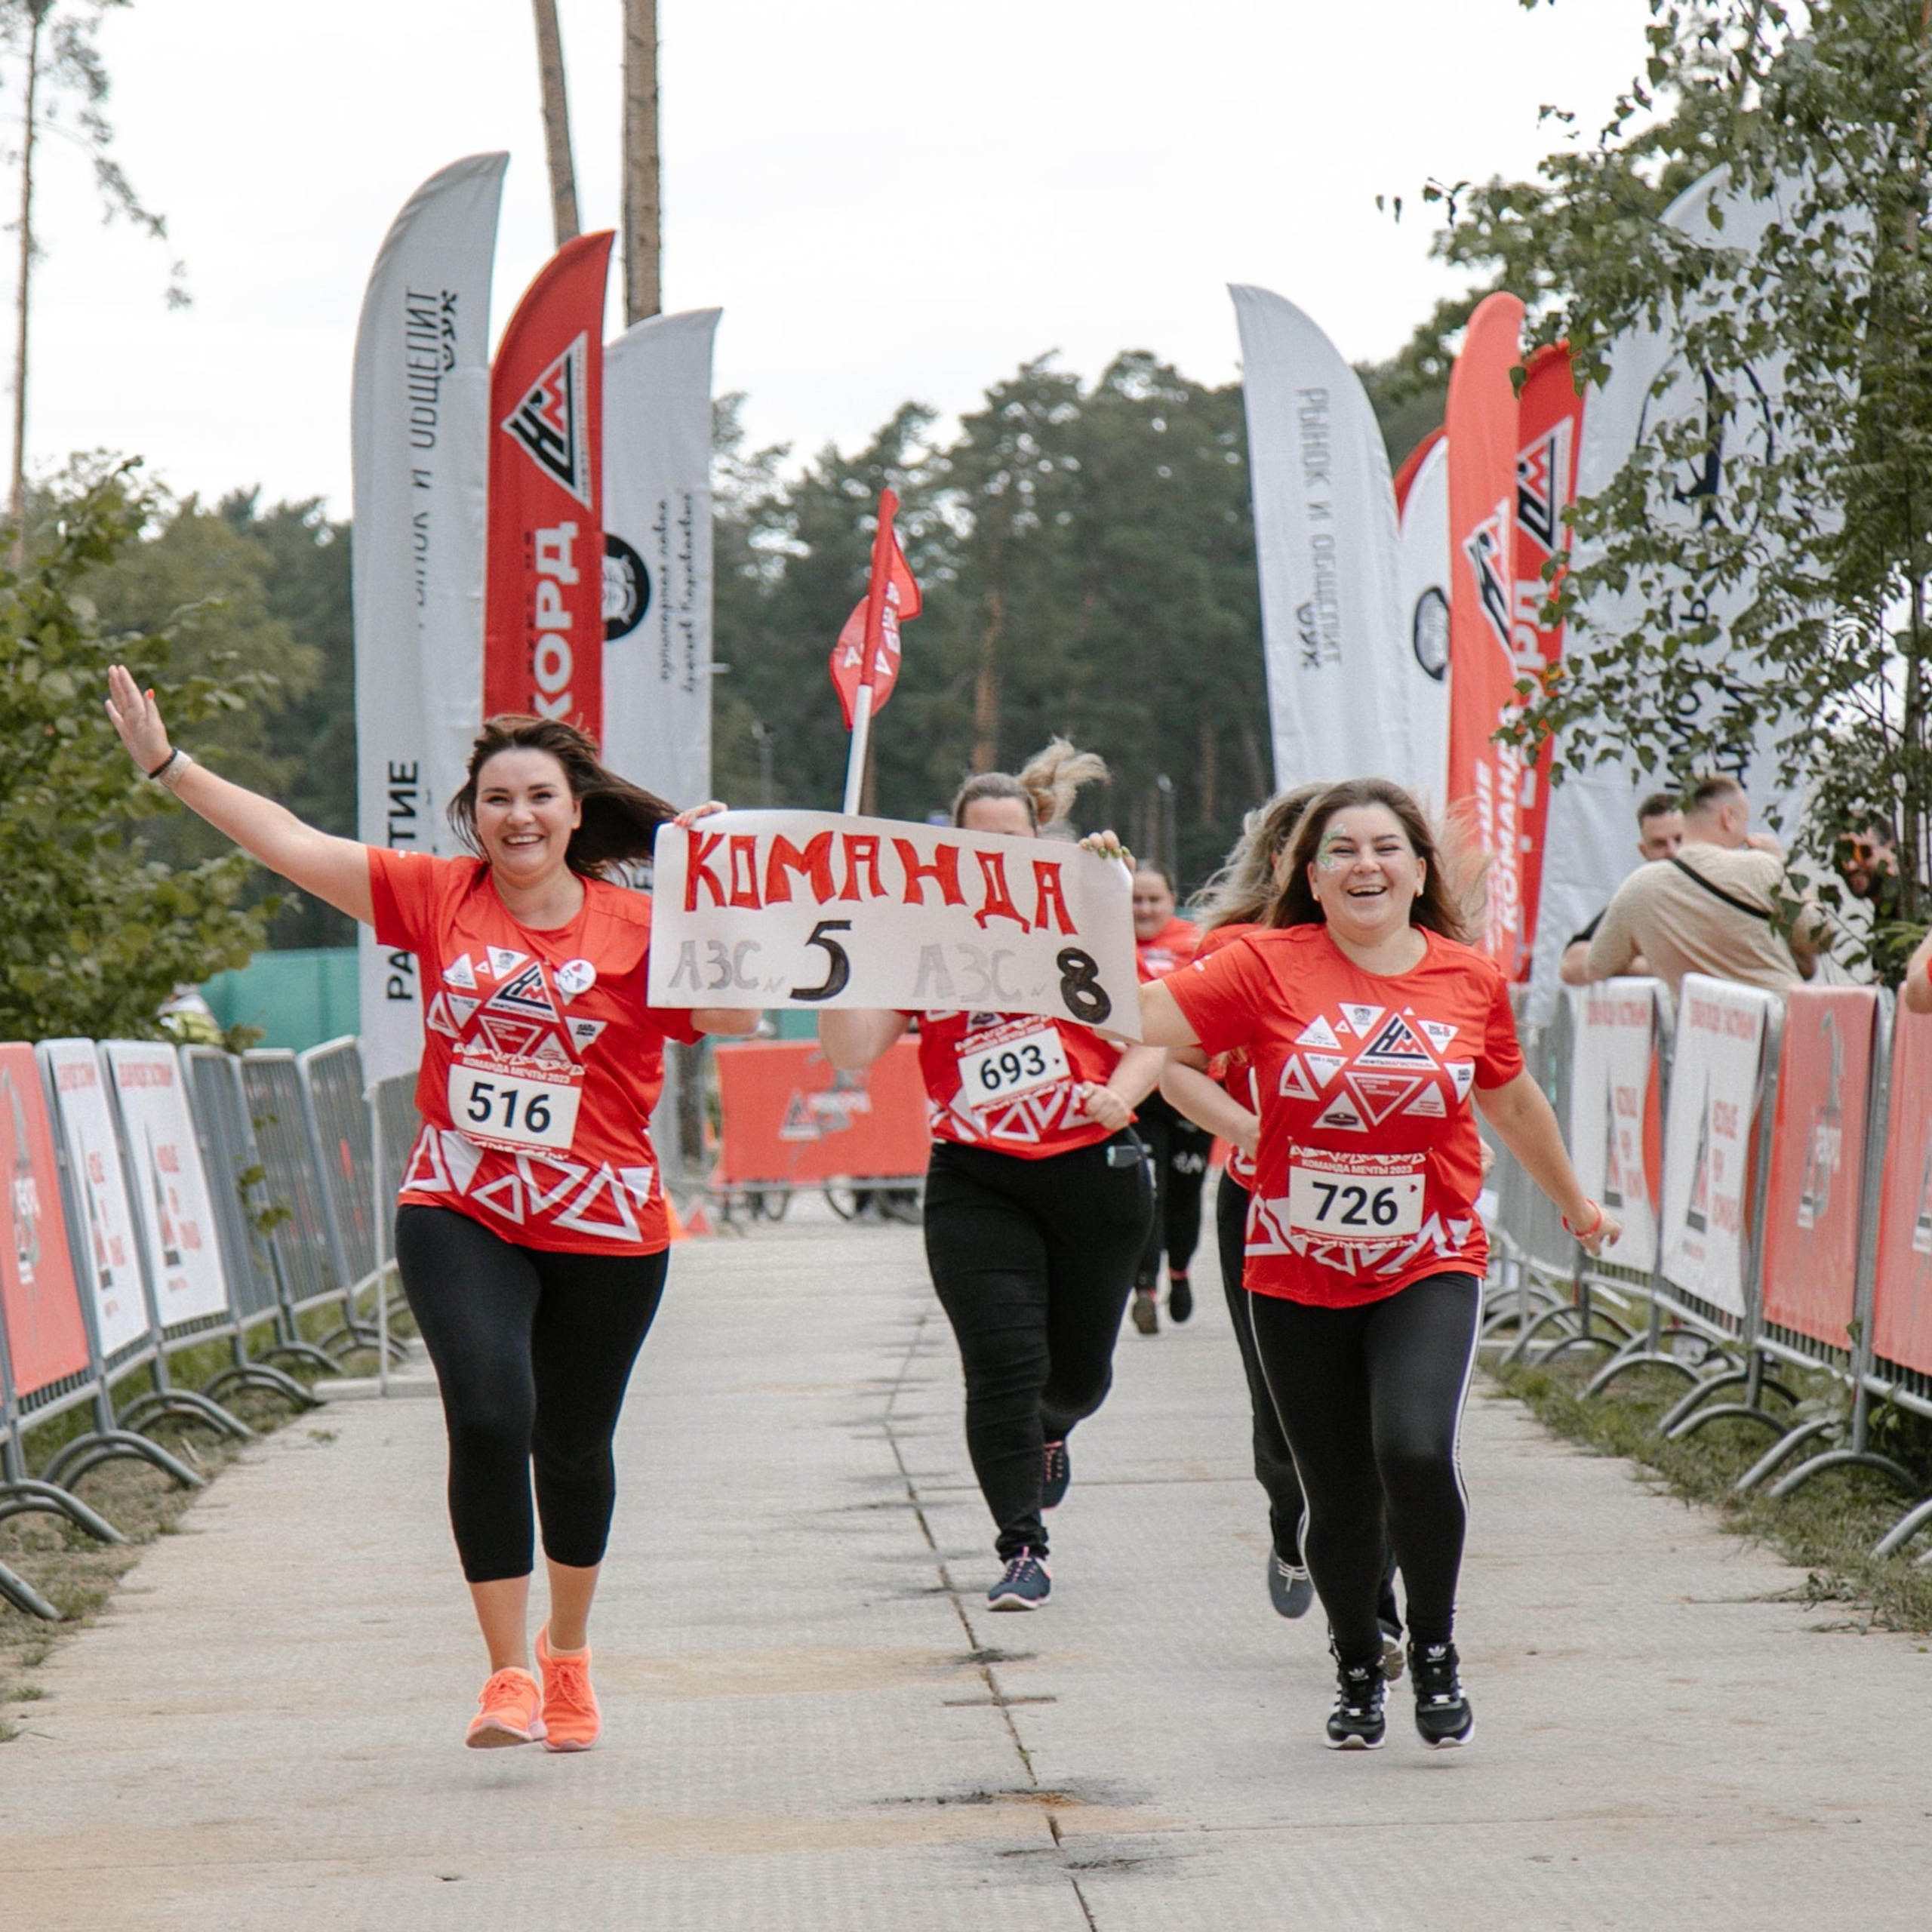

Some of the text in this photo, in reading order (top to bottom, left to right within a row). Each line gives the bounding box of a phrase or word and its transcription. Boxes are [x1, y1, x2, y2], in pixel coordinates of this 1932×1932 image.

[1295, 387, 1343, 666] РЫНОК И ОБЩЕПИТ
[386, 761, 417, 1001] РАТИЕ
[685, 830, 1078, 936] КОМАНДА
[669, 940, 761, 991] АЗС
[789, 920, 851, 1001] 5
[912, 943, 1023, 1002] АЗС
[1056, 947, 1111, 1024] 8
[980, 1044, 1045, 1090] 693
[468, 1081, 550, 1133] 516
[1302, 1159, 1350, 1174] КОМАНДА
[1352, 1164, 1389, 1175] МЕЧТЫ
[1312, 1181, 1398, 1226] 726
